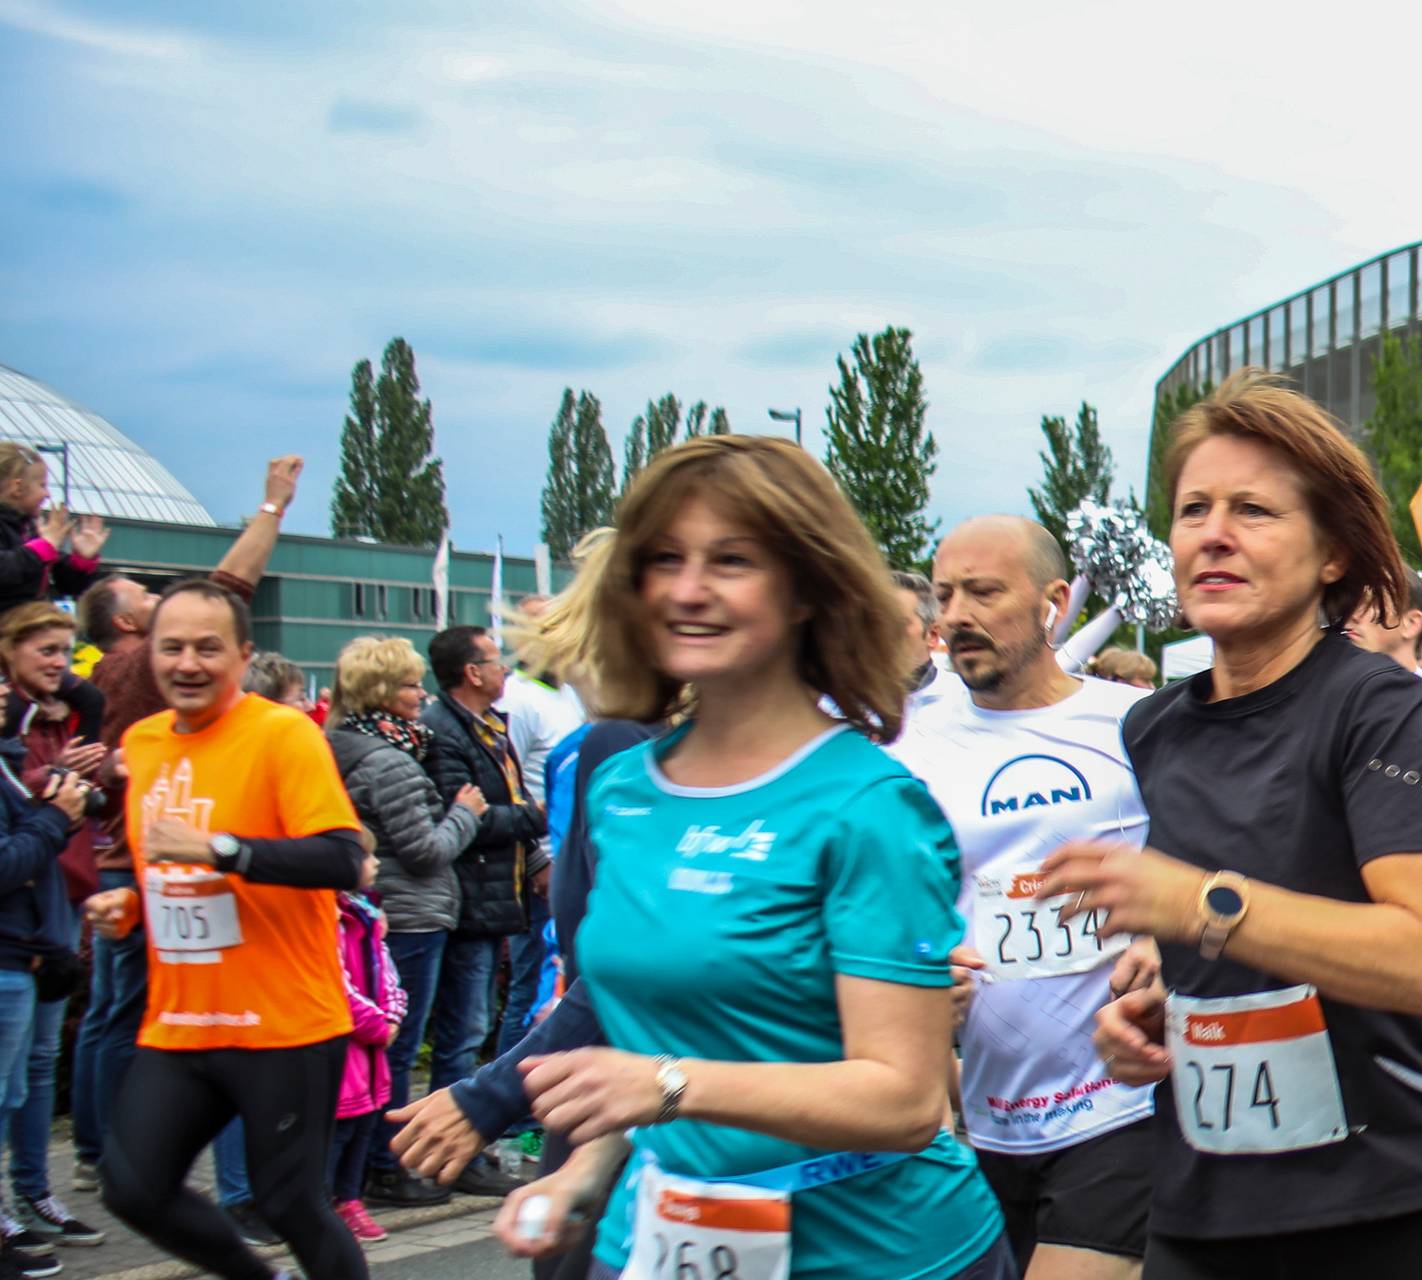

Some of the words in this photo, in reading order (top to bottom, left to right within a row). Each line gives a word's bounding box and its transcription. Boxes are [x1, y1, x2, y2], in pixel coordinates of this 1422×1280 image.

[990, 786, 1081, 817] MAN
[160, 904, 211, 940] 705
[994, 904, 1104, 964] 2334
[1185, 1059, 1280, 1132] 274
[800, 1151, 883, 1185] RWE
